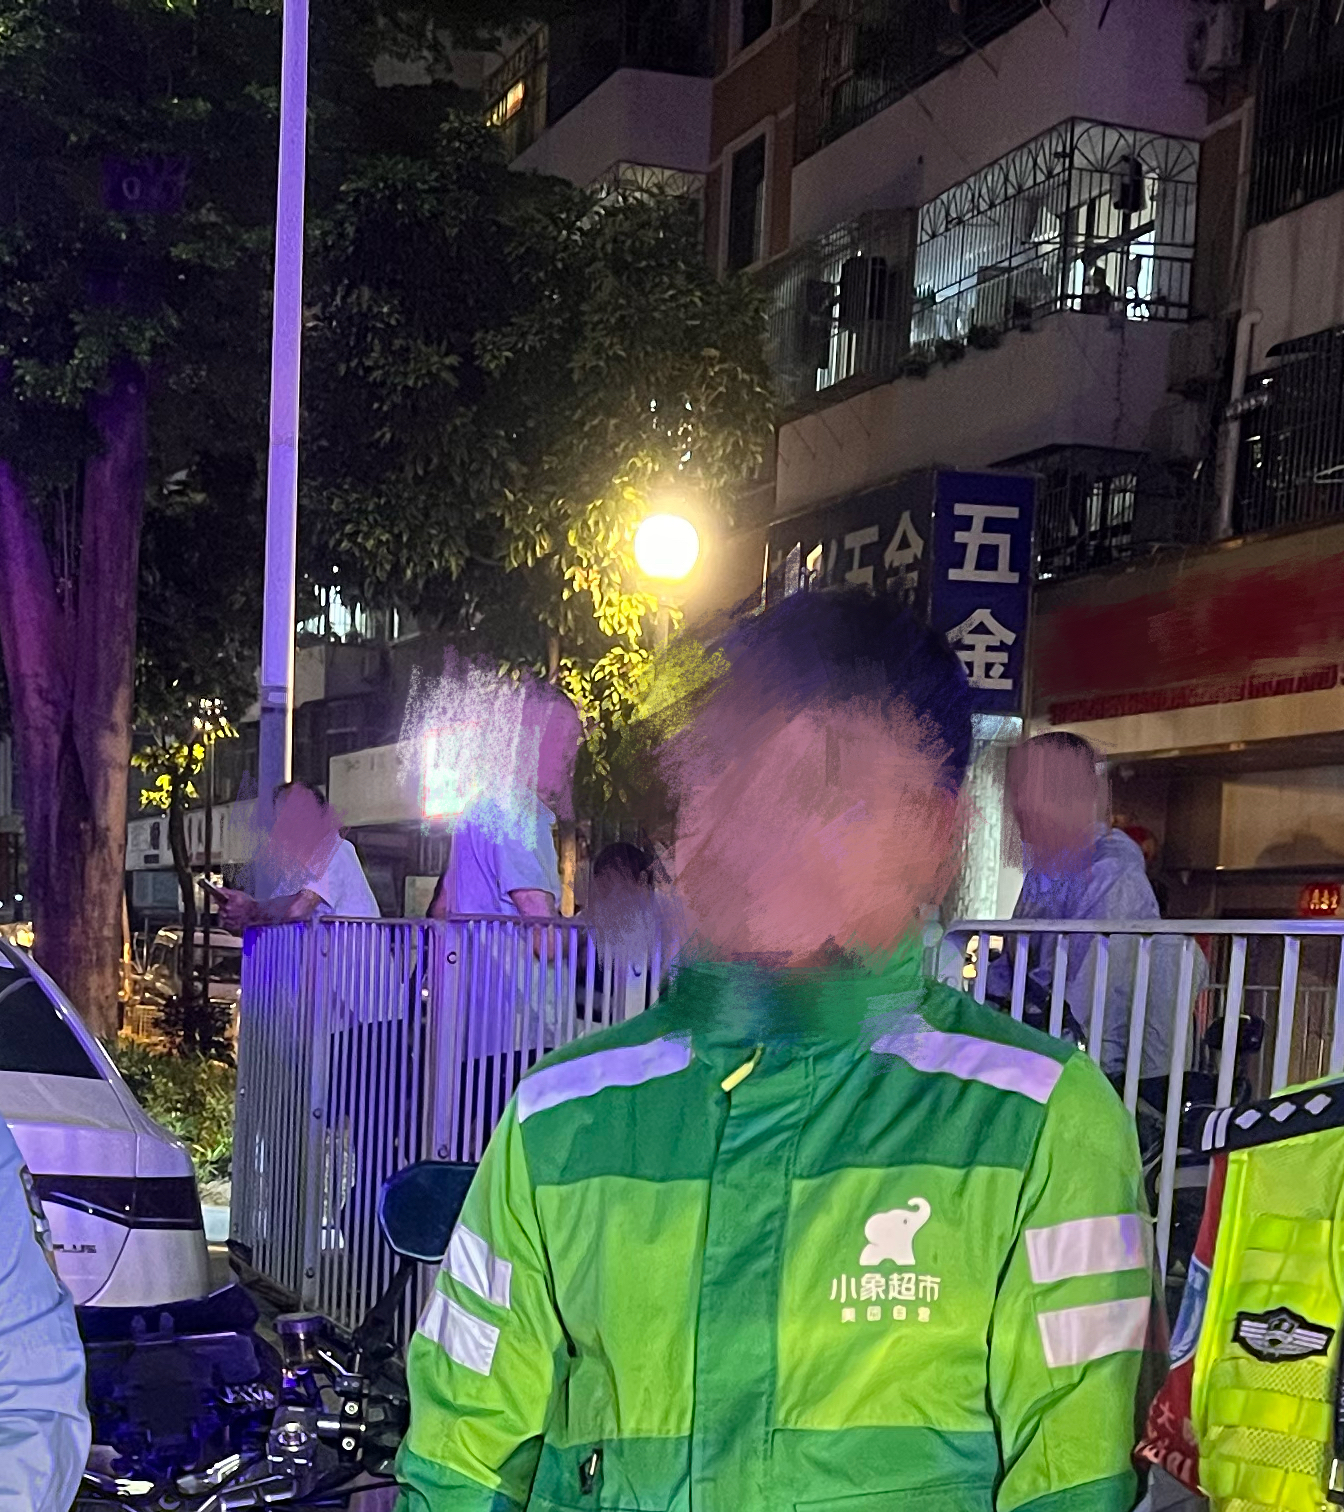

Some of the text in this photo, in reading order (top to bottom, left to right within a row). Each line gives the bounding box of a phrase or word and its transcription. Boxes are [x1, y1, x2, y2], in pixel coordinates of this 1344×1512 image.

[946, 502, 1020, 691] 五金
[830, 1272, 942, 1303] 小象超市
